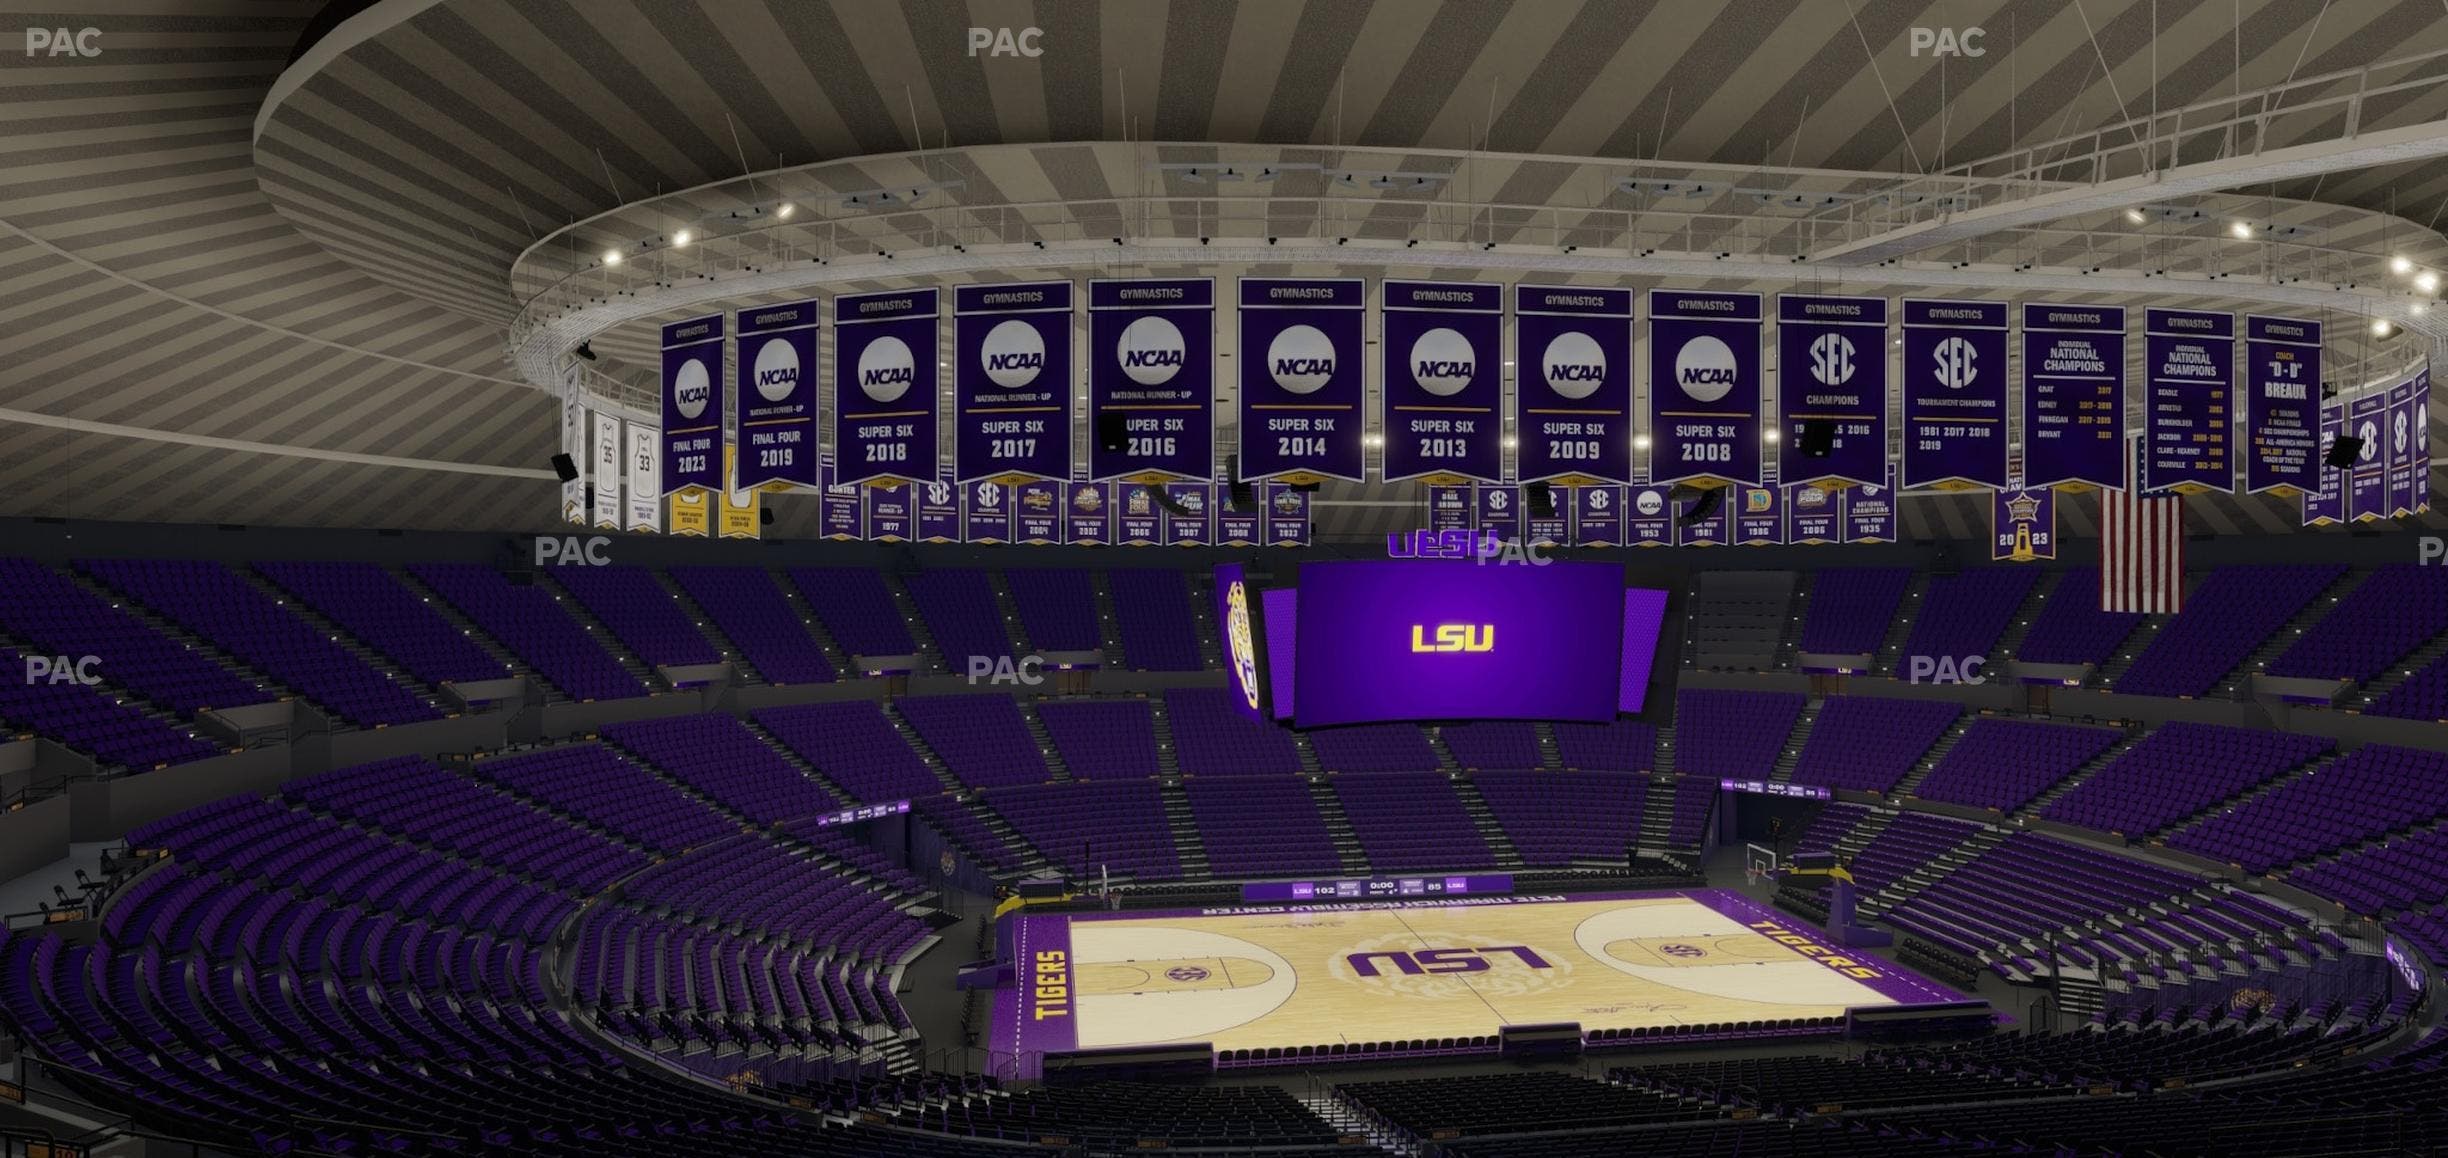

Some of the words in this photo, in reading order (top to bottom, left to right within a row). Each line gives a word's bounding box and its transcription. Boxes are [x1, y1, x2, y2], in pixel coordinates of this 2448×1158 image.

[983, 291, 1044, 305] GYMNASTICS
[1120, 288, 1184, 300] GYMNASTICS
[1270, 287, 1334, 300] GYMNASTICS
[1412, 290, 1474, 303] GYMNASTICS
[1545, 294, 1605, 307] GYMNASTICS
[859, 299, 913, 313] GYMNASTICS
[1677, 299, 1736, 312] GYMNASTICS
[1805, 303, 1861, 316] GYMNASTICS
[1929, 308, 1983, 320] GYMNASTICS
[2048, 312, 2101, 324] GYMNASTICS
[2167, 317, 2214, 329] GYMNASTICS
[2265, 323, 2304, 337] GYMNASTICS
[1125, 350, 1182, 367] NCAA
[1809, 332, 1857, 386] SEC
[2050, 347, 2099, 360] NATIONAL
[2169, 351, 2212, 365] NATIONAL
[988, 352, 1042, 371] NCAA
[1276, 359, 1333, 376] NCAA
[1933, 336, 1978, 389] SEC
[2043, 359, 2105, 372] CHAMPIONS
[864, 367, 912, 386] NCAA
[1418, 361, 1473, 378] NCAA
[1551, 364, 1603, 381] NCAA
[1683, 368, 1734, 385] NCAA
[2163, 363, 2217, 377] CHAMPIONS
[760, 368, 798, 386] NCAA
[678, 386, 708, 404] NCAA
[1111, 391, 1145, 400] NATIONAL
[2264, 381, 2307, 400] BREAUX
[974, 393, 1007, 403] NATIONAL
[1806, 395, 1860, 406] CHAMPIONS
[858, 425, 892, 438] SUPER
[896, 424, 914, 437] SIX
[982, 421, 1021, 434] SUPER
[1025, 420, 1045, 433] SIX
[1126, 419, 1159, 432] UPER
[1164, 419, 1184, 432] SIX
[1268, 419, 1309, 432] SUPER
[1314, 419, 1335, 432] SIX
[1411, 419, 1450, 432] SUPER
[1455, 420, 1475, 433] SIX
[1543, 422, 1582, 435] SUPER
[1586, 423, 1605, 436] SIX
[1675, 424, 1713, 438] SUPER
[1717, 425, 1736, 438] SIX
[1847, 424, 1870, 435] 2016
[1920, 426, 1940, 437] 1981
[1944, 426, 1965, 437] 2017
[1968, 427, 1991, 438] 2018
[752, 433, 775, 445] FINAL
[778, 430, 801, 443] FOUR
[673, 440, 690, 453] FINAL
[692, 438, 711, 450] FOUR
[866, 442, 907, 462] 2018
[991, 439, 1037, 459] 2017
[1127, 437, 1176, 457] 2016
[1278, 437, 1327, 457] 2014
[1420, 438, 1467, 457] 2013
[1550, 440, 1600, 460] 2009
[1681, 443, 1731, 462] 2008
[1919, 440, 1942, 451] 2019
[639, 454, 651, 472] 33
[678, 455, 706, 473] 2023
[760, 449, 793, 467] 2019
[977, 481, 1000, 508] SEC
[1852, 506, 1889, 514] CHAMPIONS
[1855, 500, 1886, 508] NATIONAL
[1640, 529, 1659, 538] 1953
[1859, 524, 1881, 533] 1935
[1999, 533, 2015, 546] 20
[2032, 532, 2048, 545] 23
[1412, 624, 1494, 653] LSU
[1314, 886, 1335, 895] 102
[1370, 881, 1394, 889] 0:00
[1202, 905, 1286, 916] CENTER
[1290, 900, 1401, 913] ASSEMBLY
[1749, 921, 1883, 980] TIGERS
[1346, 945, 1554, 977] LSU
[1035, 949, 1068, 1020] TIGERS
